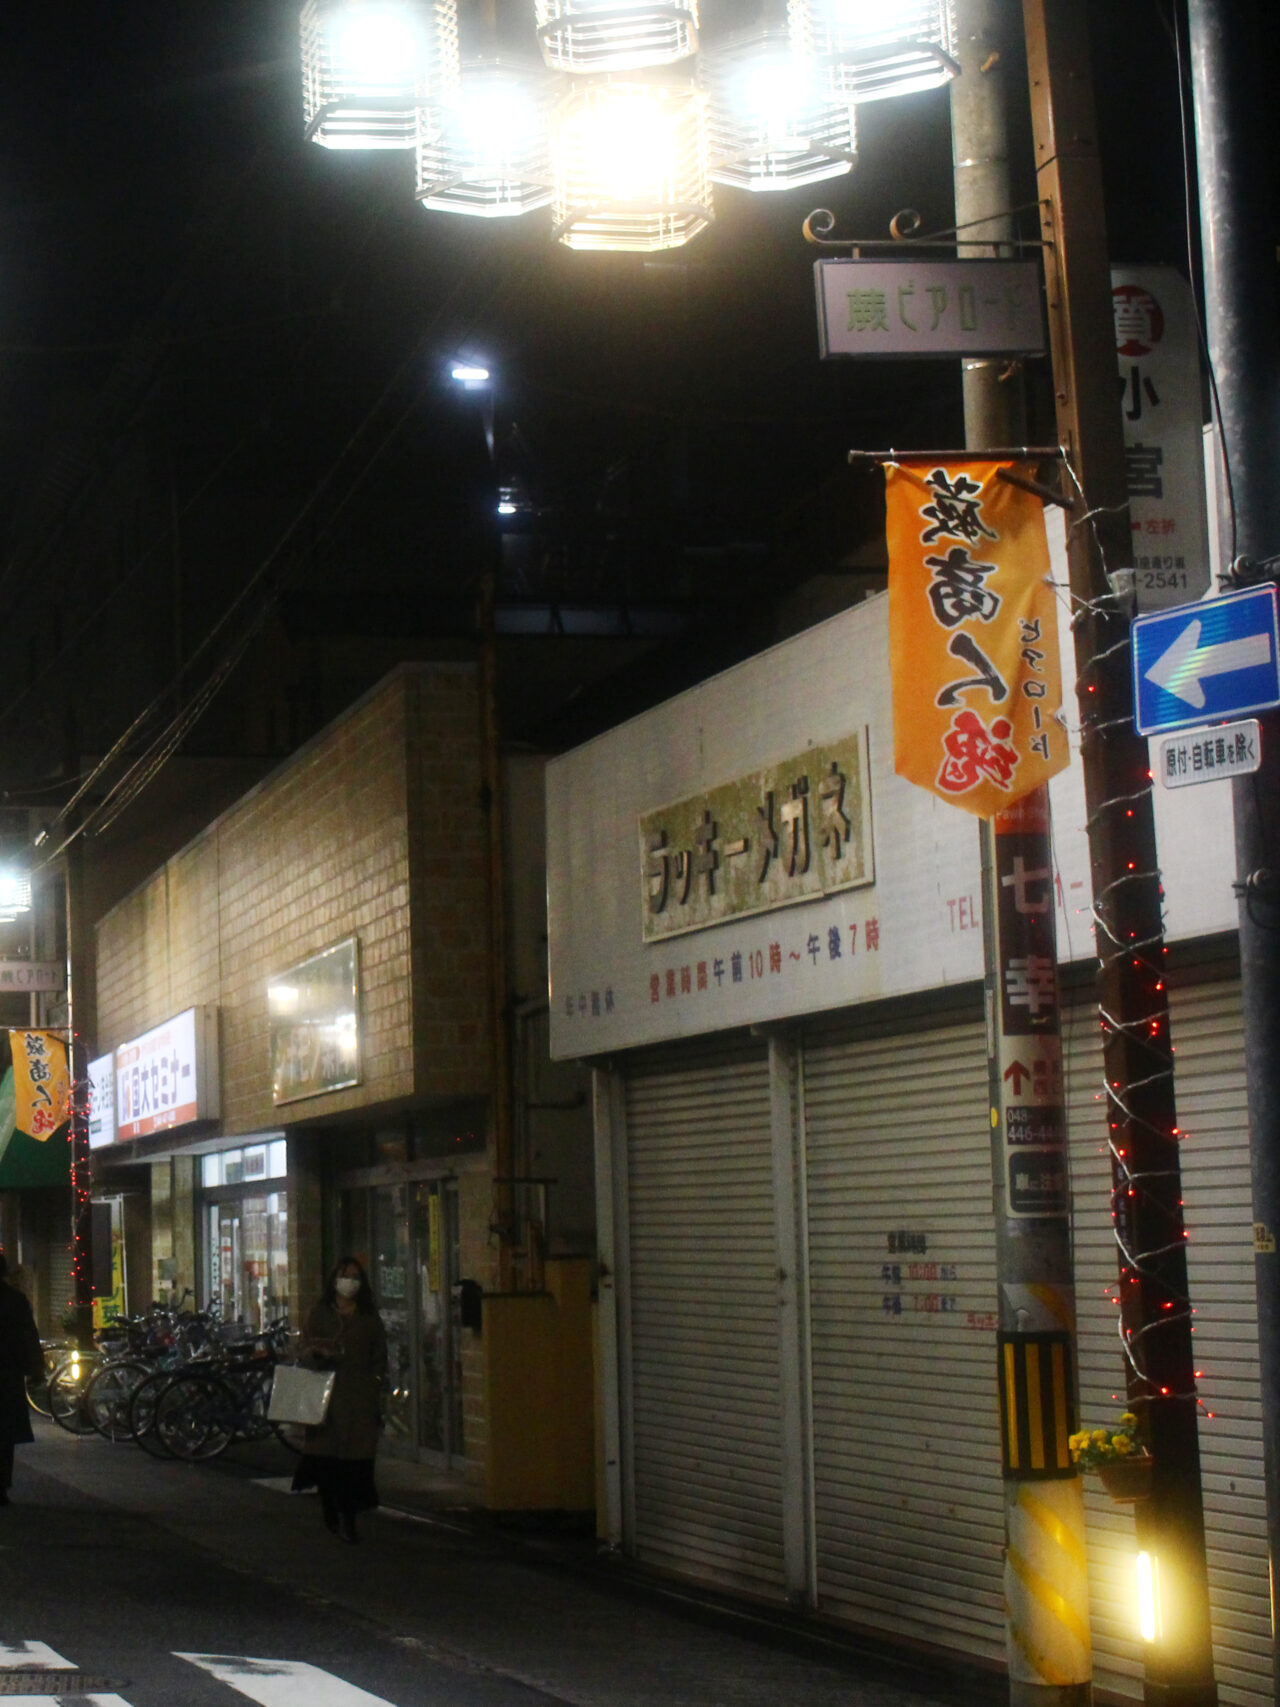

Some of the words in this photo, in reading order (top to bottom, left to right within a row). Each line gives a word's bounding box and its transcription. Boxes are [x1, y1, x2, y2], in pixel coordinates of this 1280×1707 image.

[647, 761, 851, 914] ラッキーメガネ
[946, 896, 979, 933] TEL
